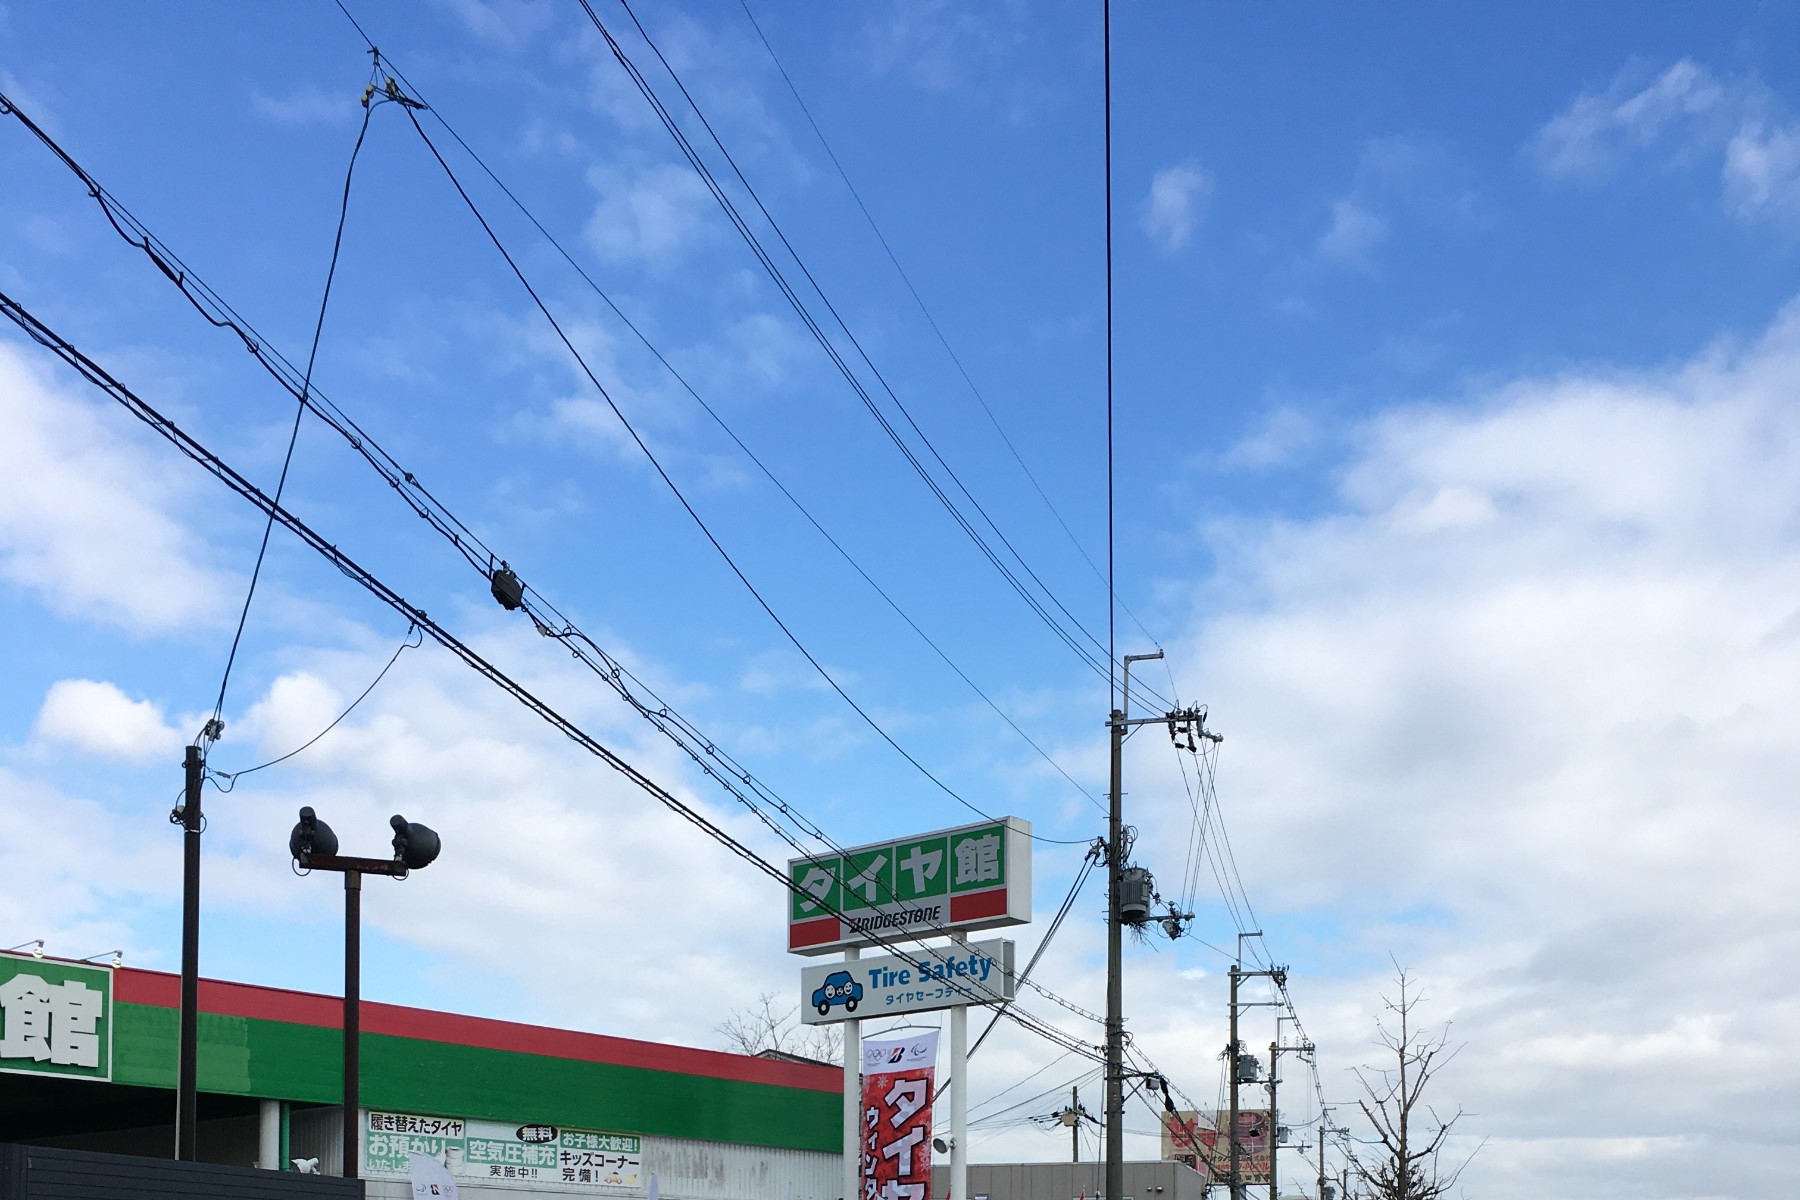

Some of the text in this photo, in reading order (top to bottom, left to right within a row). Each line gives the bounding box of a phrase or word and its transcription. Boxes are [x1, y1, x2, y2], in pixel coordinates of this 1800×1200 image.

[798, 833, 1001, 913] タイヤ館
[849, 905, 942, 933] BRIDGESTONE
[868, 955, 993, 989] Tire Safety
[0, 973, 103, 1068] 館
[371, 1114, 462, 1137] 履き替えたタイヤ
[522, 1126, 554, 1141] 無料
[469, 1140, 556, 1167] 空気圧補充
[560, 1151, 640, 1170] キッズコーナー
[489, 1165, 538, 1179] 実施中!!
